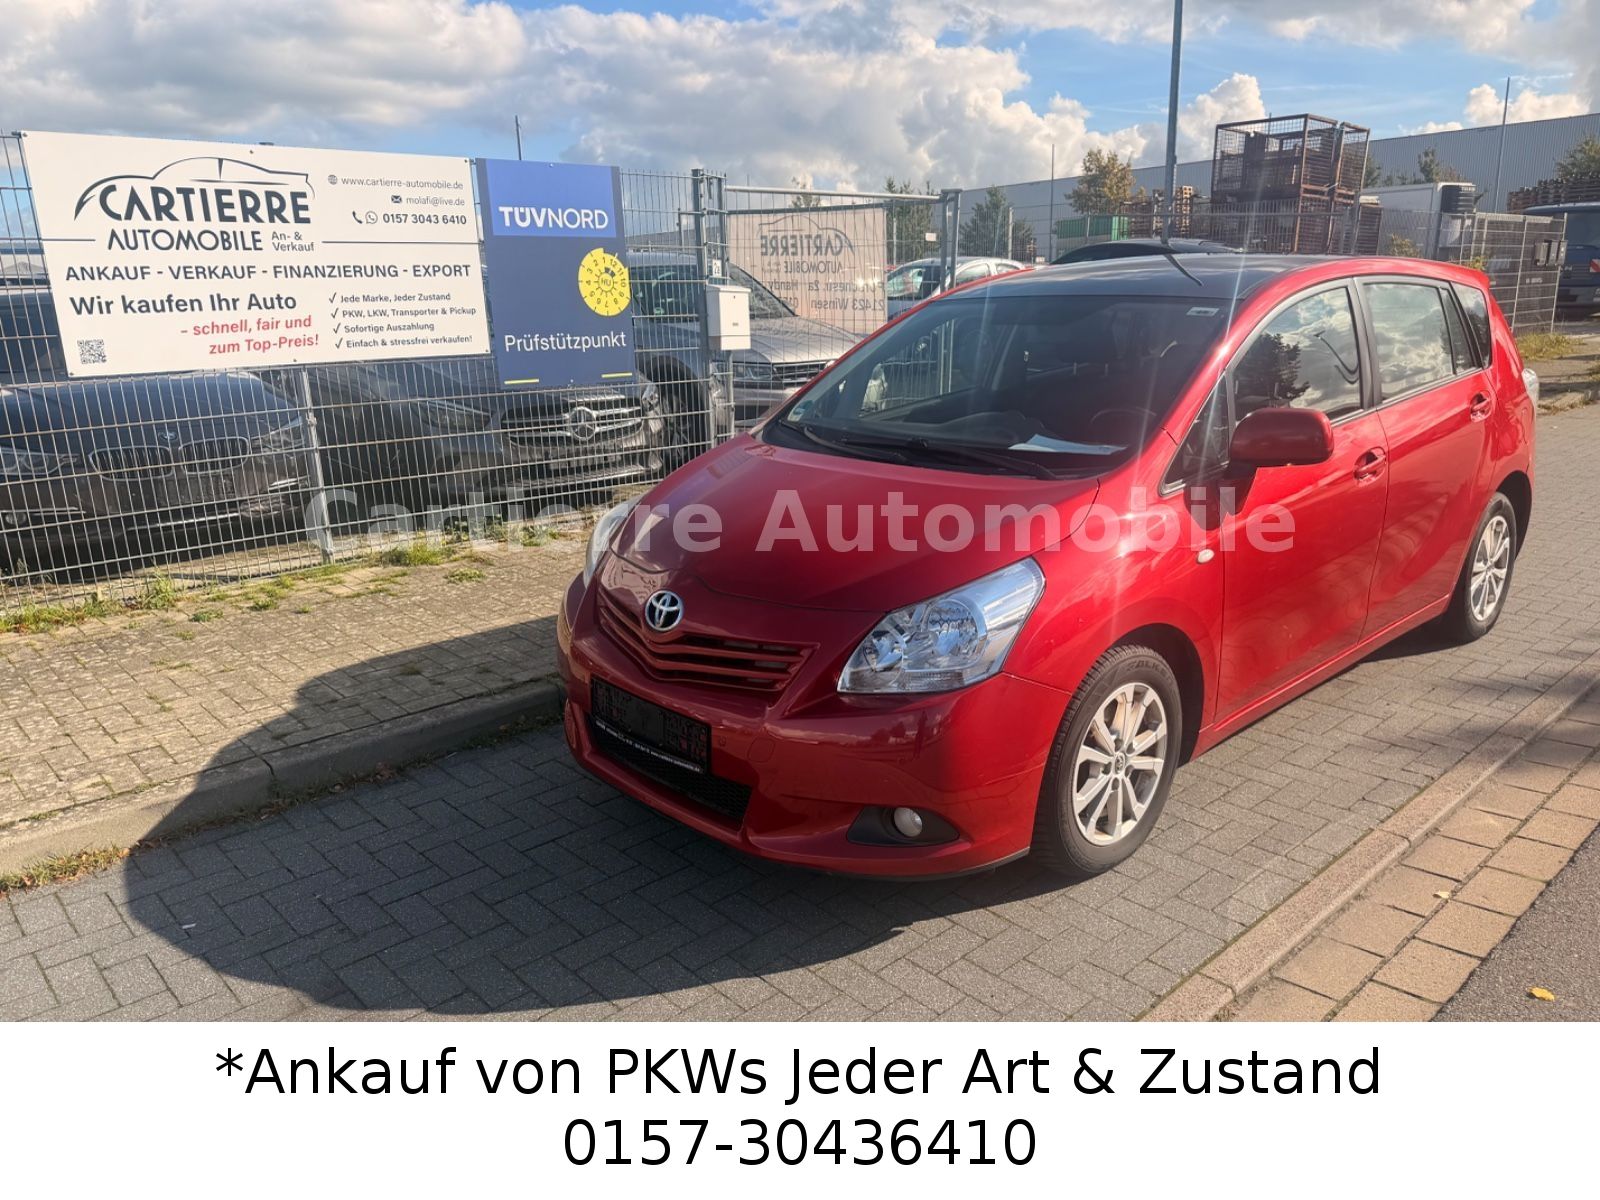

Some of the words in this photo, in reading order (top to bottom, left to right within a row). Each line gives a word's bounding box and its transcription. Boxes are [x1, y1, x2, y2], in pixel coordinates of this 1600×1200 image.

[341, 178, 464, 190] www.cartierre-automobile.de
[99, 184, 311, 224] CARTIERRE
[406, 196, 465, 206] molafi@live.de
[383, 213, 408, 224] 0157
[411, 214, 440, 224] 3043
[442, 214, 467, 225] 6410
[108, 228, 263, 251] AUTOMOBILE
[271, 231, 291, 241] An-
[294, 231, 303, 241] &
[272, 241, 315, 252] Verkauf
[65, 265, 151, 281] ANKAUF
[168, 265, 257, 280] VERKAUF
[273, 264, 399, 279] FINANZIERUNG
[413, 264, 471, 277] EXPORT
[69, 296, 114, 315] Wir
[121, 294, 203, 314] kaufen
[210, 293, 240, 311] Ihr
[247, 293, 297, 310] Auto
[340, 294, 360, 303] Jede
[362, 293, 392, 304] Marke,
[394, 293, 416, 302] Jeder
[418, 292, 451, 301] Zustand
[342, 309, 366, 319] PKW,
[367, 308, 390, 318] LKW,
[391, 307, 439, 318] Transporter
[441, 307, 448, 315] &
[449, 306, 477, 317] Pickup
[193, 319, 252, 336] schnell,
[256, 317, 281, 331] fair
[285, 315, 312, 330] und
[344, 323, 384, 335] Sofortige
[386, 322, 435, 334] Auszahlung
[209, 343, 240, 355] zum
[244, 334, 319, 353] Top-Preis!
[346, 338, 379, 348] Einfach
[380, 338, 388, 347] &
[390, 336, 429, 346] stressfrei
[430, 335, 473, 345] verkaufen!
[504, 331, 627, 353] Prüfstützpunkt
